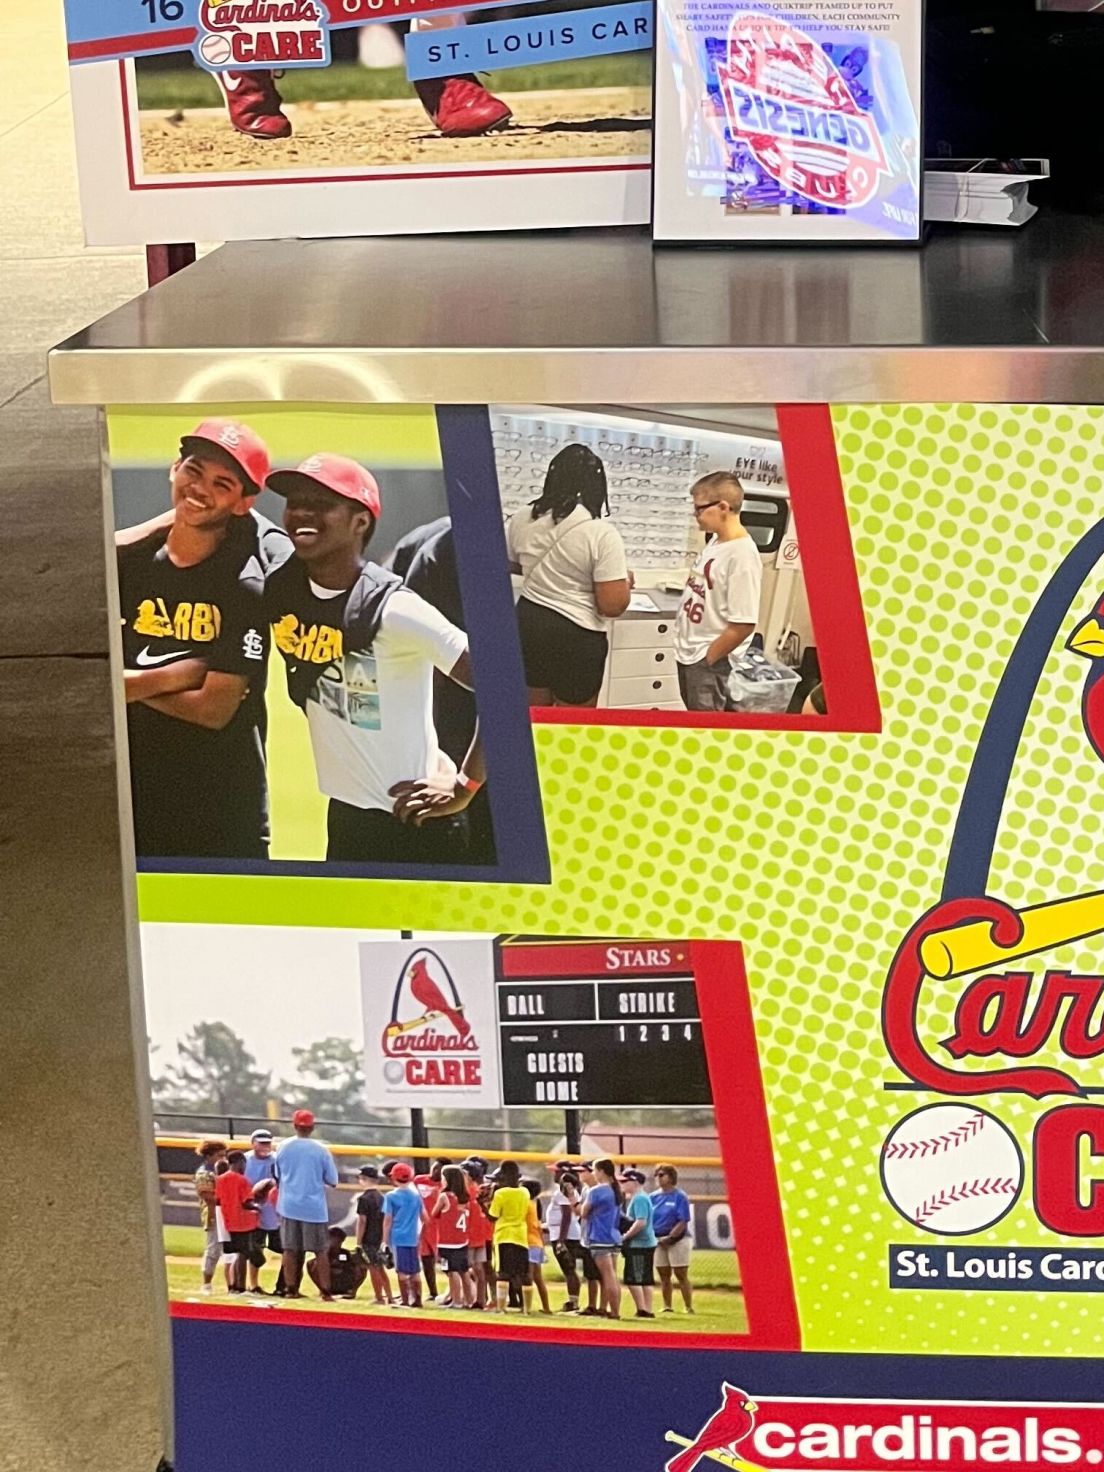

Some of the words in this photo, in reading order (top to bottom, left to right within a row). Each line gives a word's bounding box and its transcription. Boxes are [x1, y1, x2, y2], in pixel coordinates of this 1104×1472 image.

[700, 2, 751, 10] CARDINALS
[815, 2, 851, 10] TEAMED
[846, 13, 901, 21] COMMUNITY
[231, 28, 324, 63] CARE
[427, 44, 470, 65] ST.
[487, 26, 576, 57] LOUIS
[735, 457, 756, 470] EYE
[757, 460, 778, 473] like
[507, 994, 545, 1016] BALL
[618, 991, 676, 1014] STRIKE
[381, 1022, 480, 1058] Cardinals
[619, 1024, 626, 1042] 1
[639, 1024, 648, 1042] 2
[661, 1024, 670, 1041] 3
[683, 1024, 693, 1041] 4
[404, 1058, 482, 1086] CARE
[526, 1052, 585, 1074] GUESTS
[535, 1081, 579, 1102] HOME
[896, 1251, 939, 1279] St.
[946, 1252, 1033, 1281] Louis
